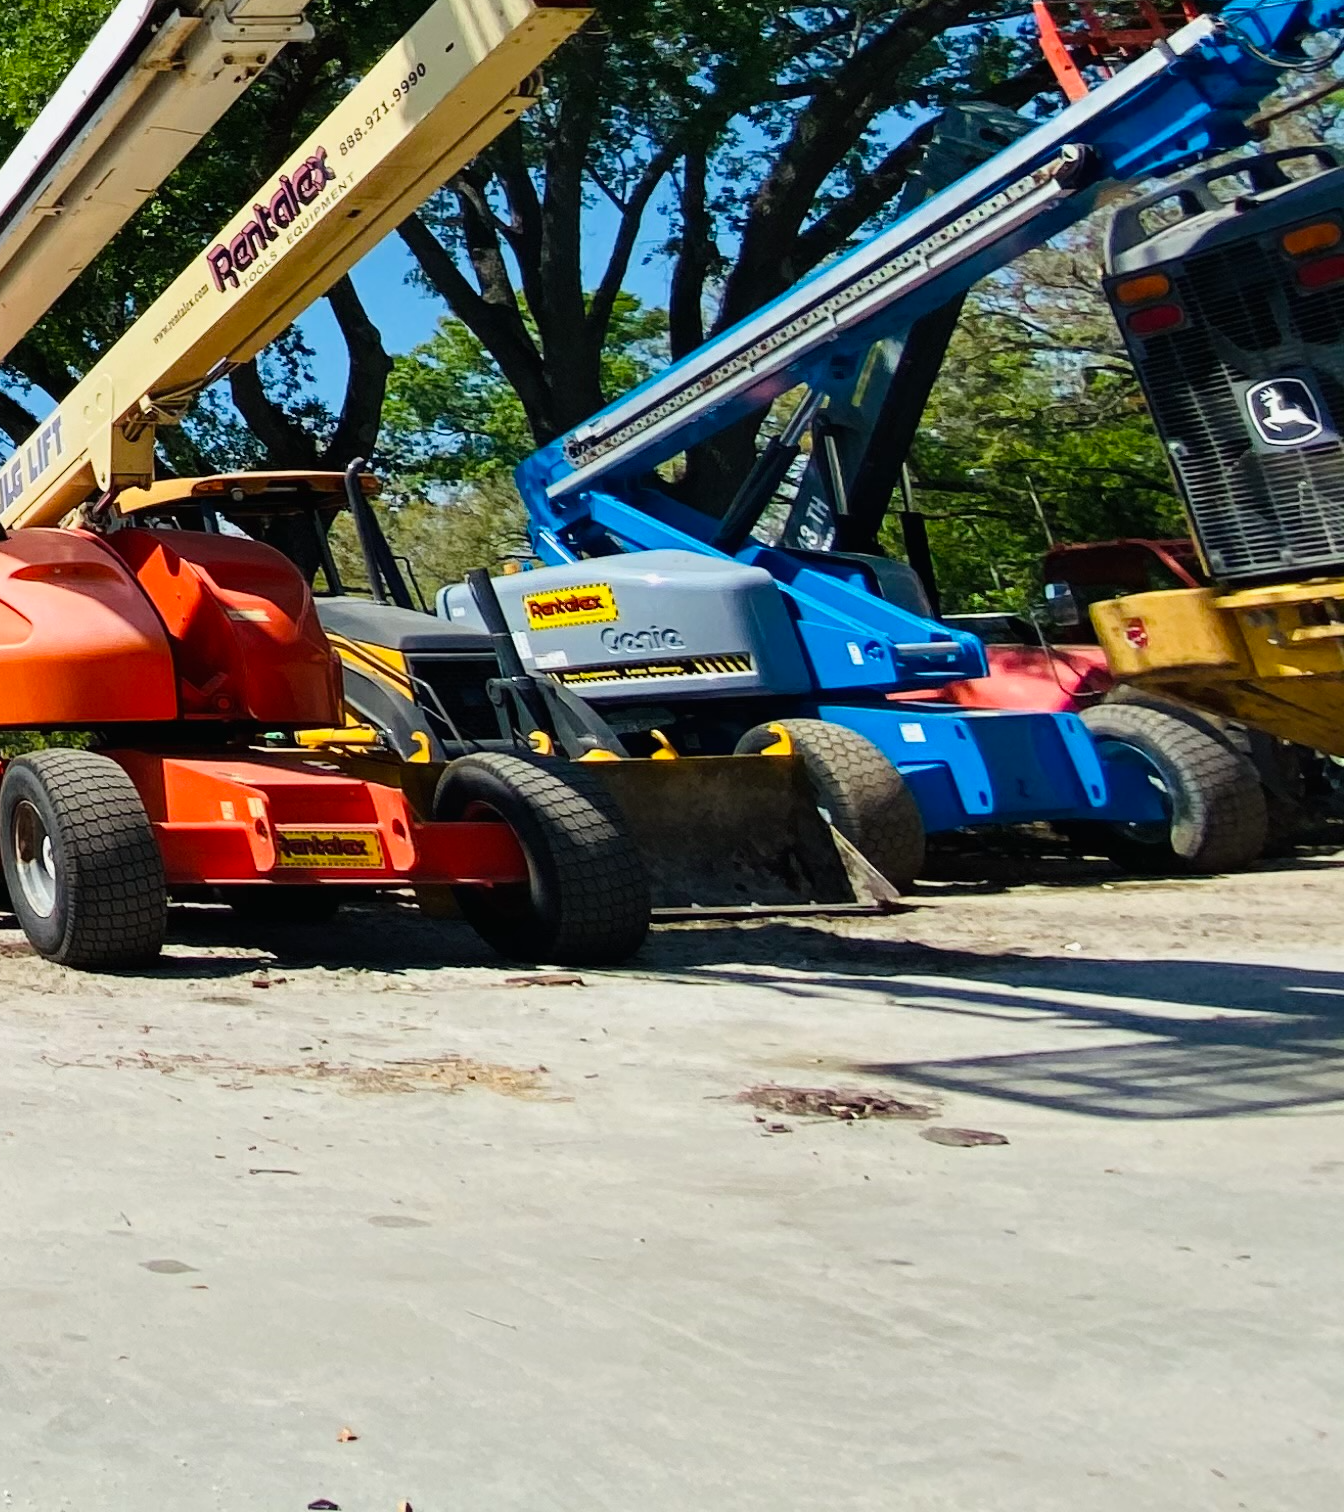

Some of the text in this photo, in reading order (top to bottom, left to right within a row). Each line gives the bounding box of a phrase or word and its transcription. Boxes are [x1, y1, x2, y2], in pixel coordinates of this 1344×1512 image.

[339, 62, 427, 157] 888.971.9990
[206, 145, 337, 294] Rentalex
[242, 171, 356, 288] TOOLS EQUIPMENT
[153, 284, 209, 345] www.rentalex.com
[27, 415, 62, 485] LIFT
[806, 495, 830, 525] TH
[528, 595, 605, 620] Rentalex
[601, 625, 687, 654] Genie
